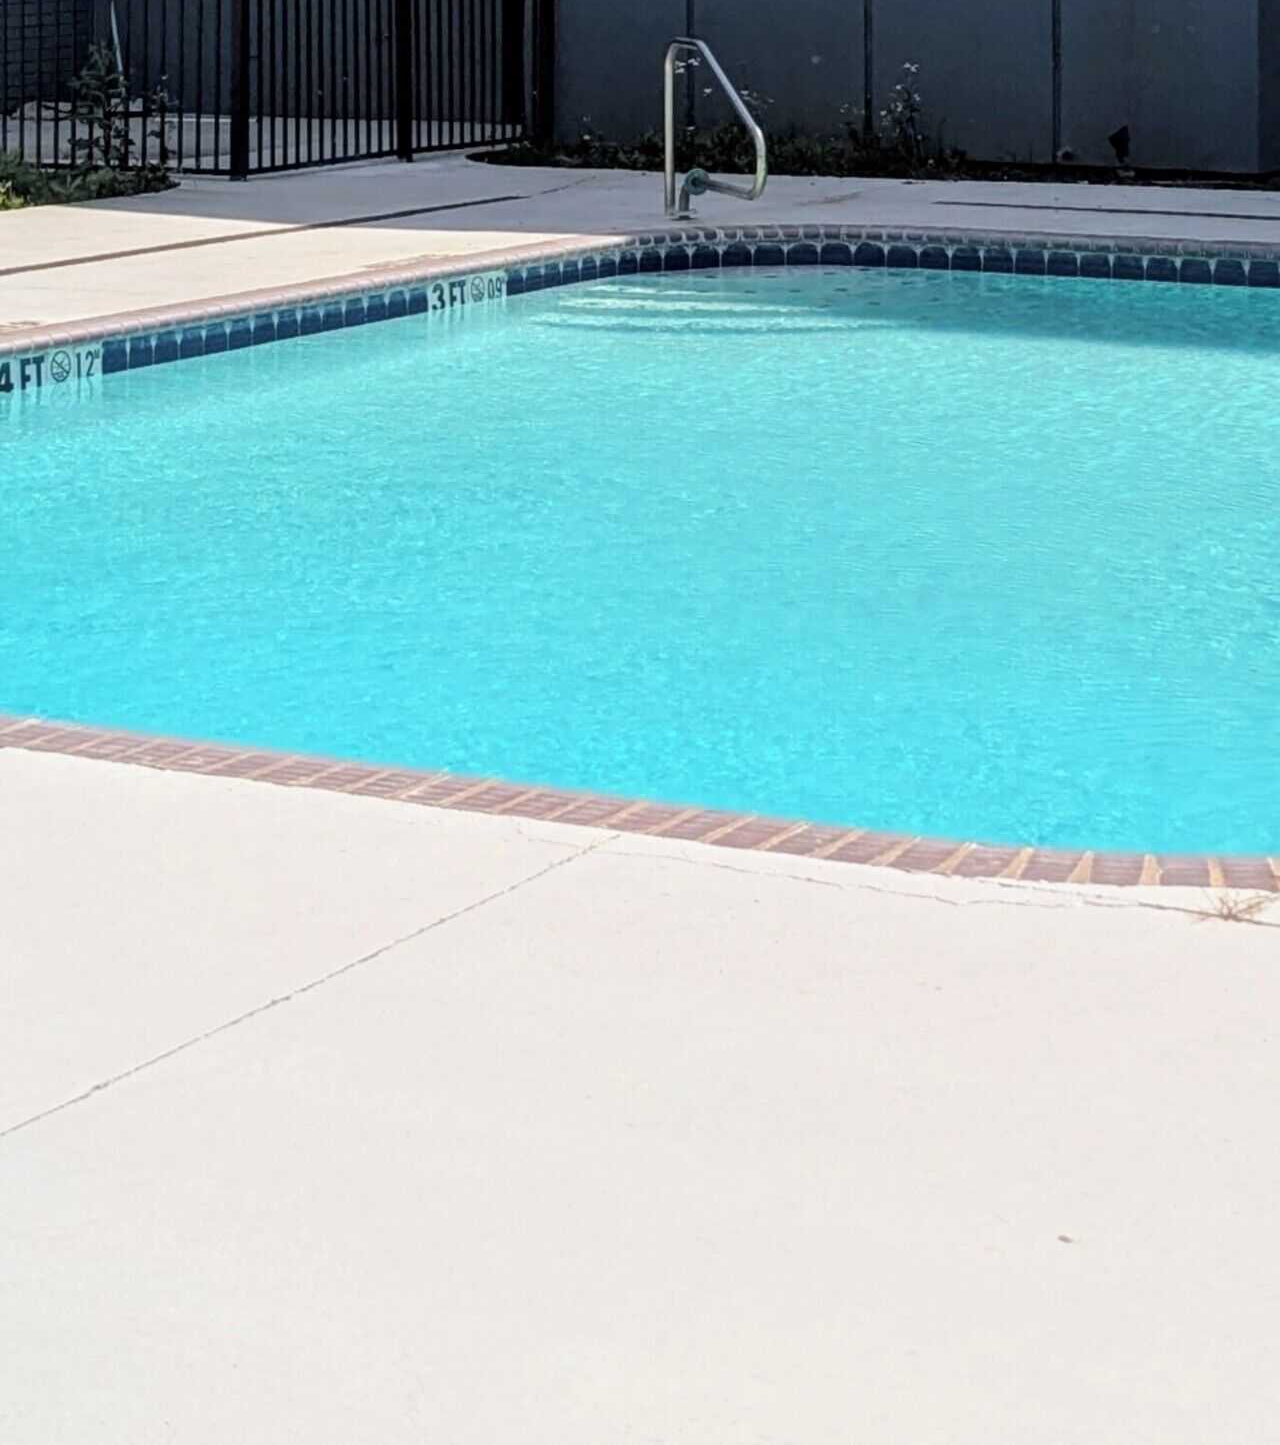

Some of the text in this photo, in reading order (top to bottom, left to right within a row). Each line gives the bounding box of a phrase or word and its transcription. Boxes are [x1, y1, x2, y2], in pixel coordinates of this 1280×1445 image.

[431, 283, 446, 310] 3
[449, 280, 467, 307] FT
[20, 355, 45, 390] FT
